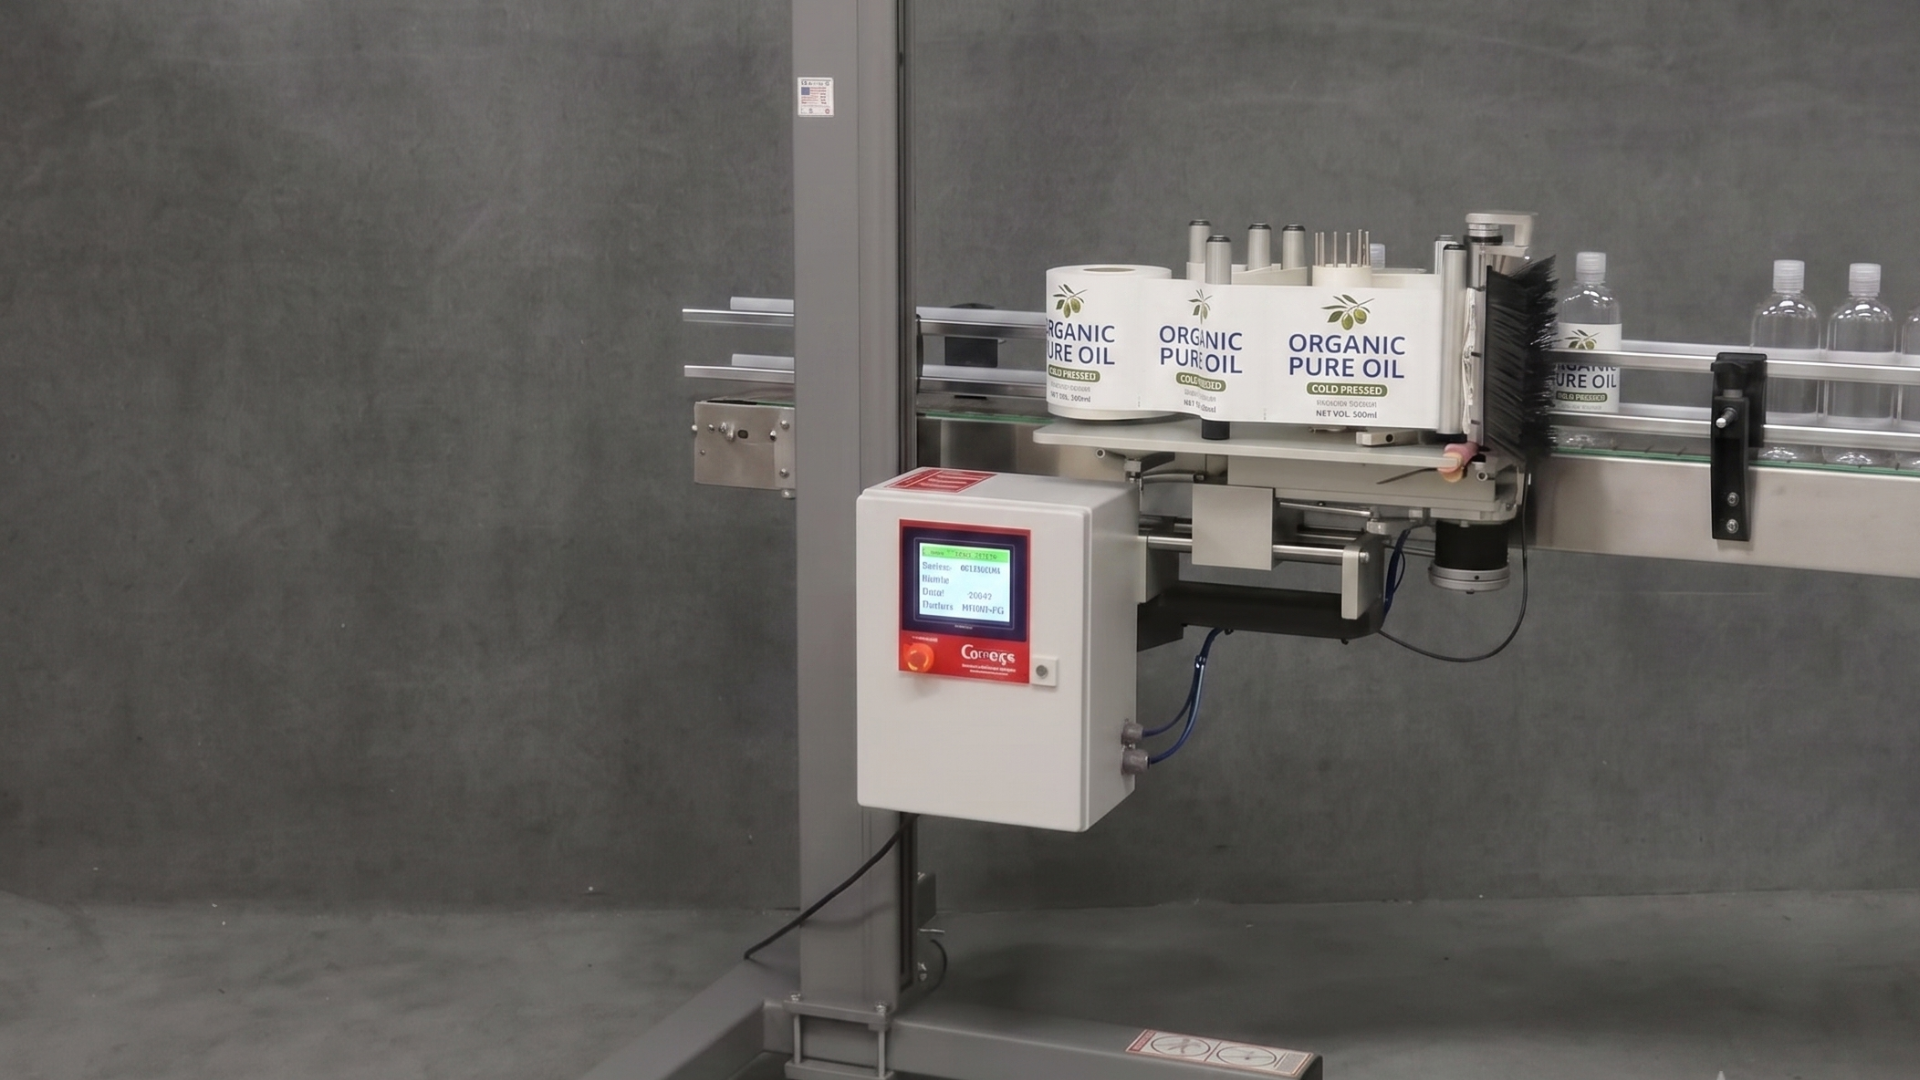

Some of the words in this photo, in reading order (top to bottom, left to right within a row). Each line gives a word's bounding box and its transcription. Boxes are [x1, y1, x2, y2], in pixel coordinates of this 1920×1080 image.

[1046, 318, 1115, 343] RGANIC
[1159, 325, 1243, 351] ORGANIC
[1047, 340, 1073, 363] URE
[1078, 346, 1115, 365] OIL
[1288, 333, 1406, 356] ORGANIC
[1160, 347, 1203, 370] PURE
[1205, 353, 1243, 374] OIL
[1289, 356, 1355, 378] PURE
[1362, 358, 1405, 379] OIL
[1062, 369, 1096, 381] PRESSED
[1556, 372, 1588, 388] URE
[1592, 374, 1617, 389] OIL
[1311, 384, 1339, 394] COLD
[1340, 385, 1383, 396] PRESSED
[1316, 409, 1332, 417] NET
[1352, 410, 1378, 419] 500ml
